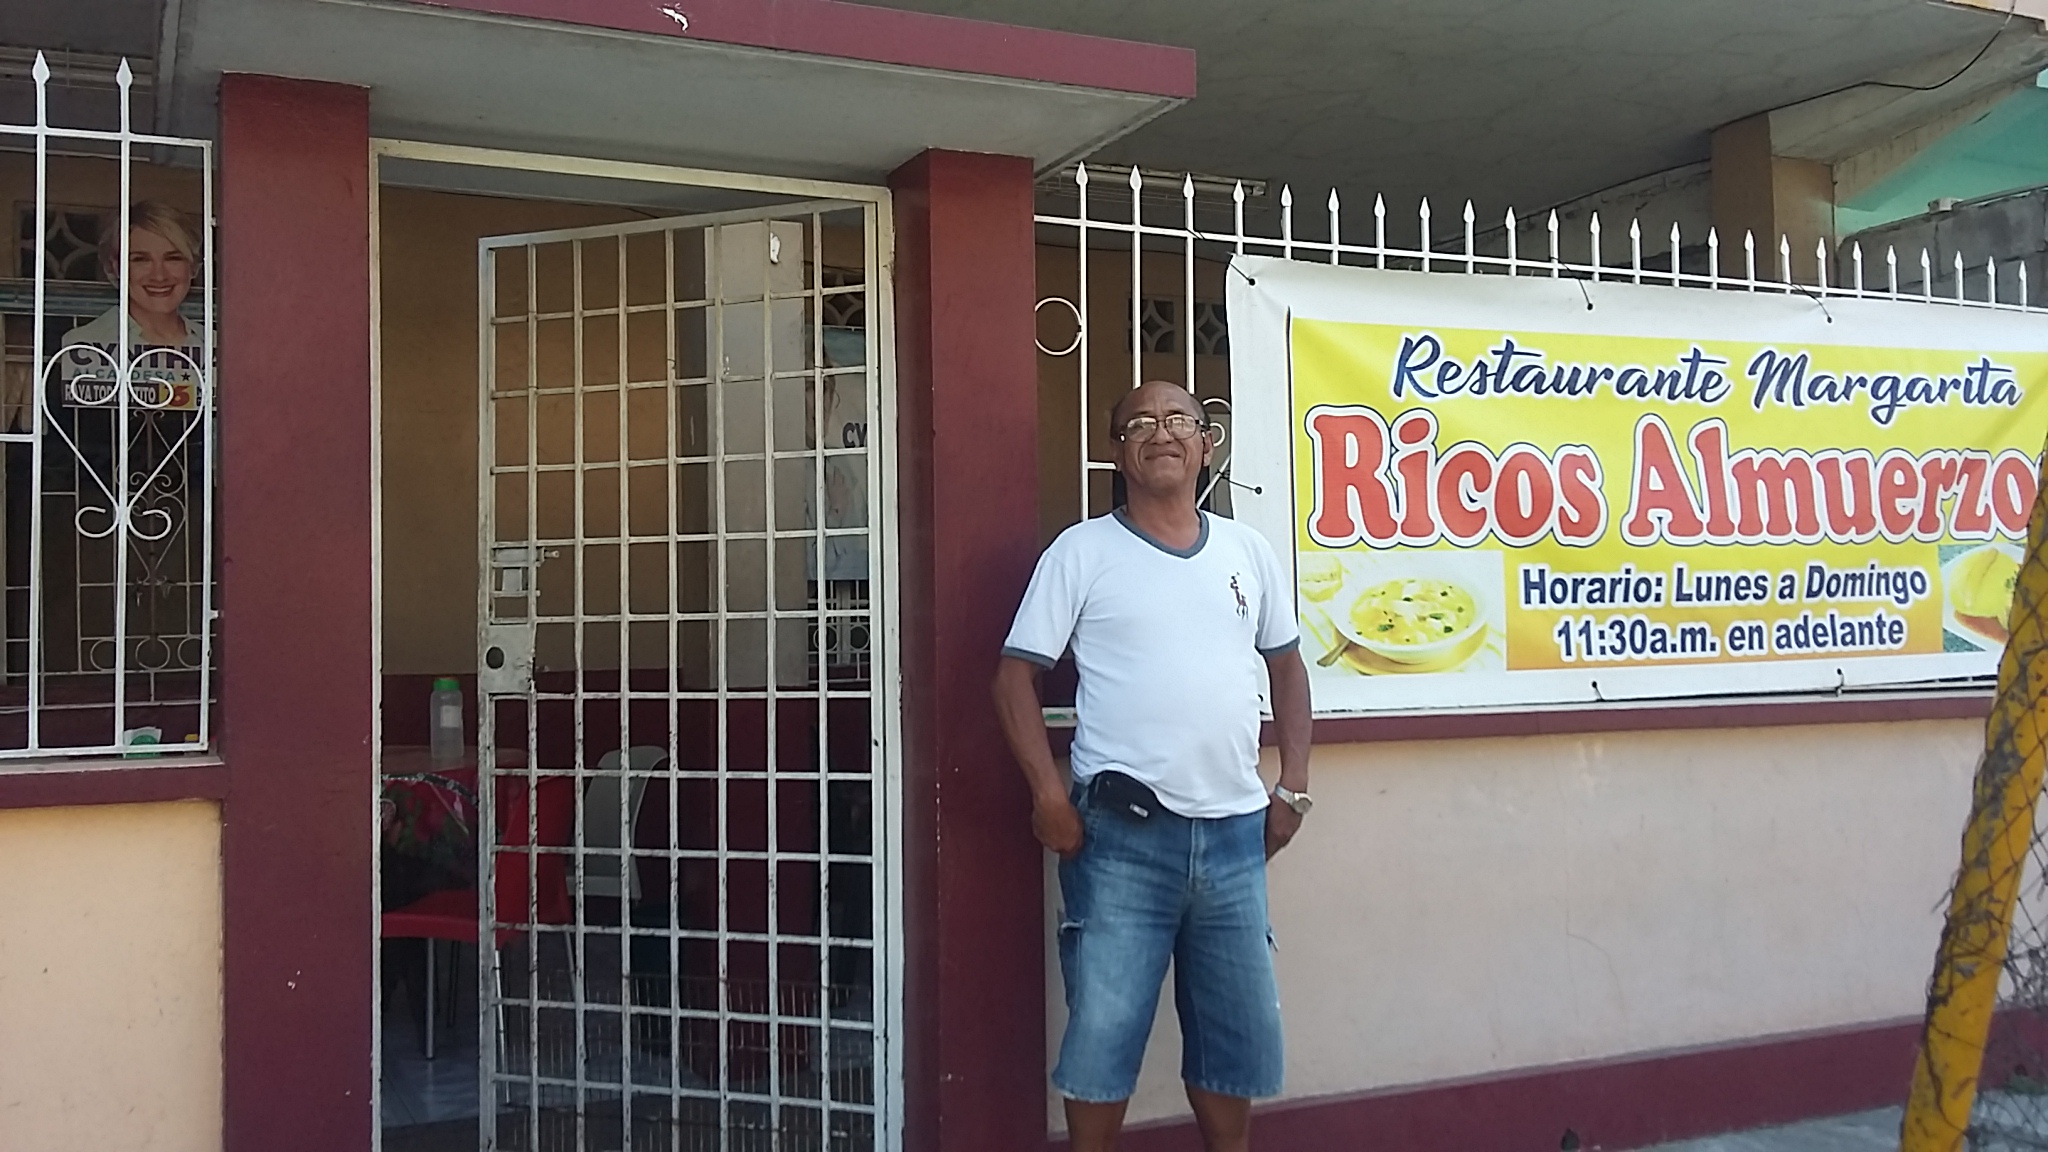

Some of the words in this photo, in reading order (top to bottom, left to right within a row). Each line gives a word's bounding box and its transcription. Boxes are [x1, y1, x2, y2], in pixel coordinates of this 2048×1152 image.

[68, 341, 216, 370] CYNTHI
[1393, 334, 1732, 403] Restaurante
[1747, 349, 2024, 425] Margarita
[1306, 406, 1608, 547] Ricos
[1621, 414, 2042, 545] Almuerzo
[1522, 567, 1664, 605] Horario:
[1675, 567, 1769, 602] Lunes
[1777, 574, 1796, 600] a
[1805, 563, 1928, 605] Domingo
[1557, 618, 1717, 657] 11:30a.m.
[1728, 624, 1765, 651] en
[1774, 612, 1905, 650] adelante
